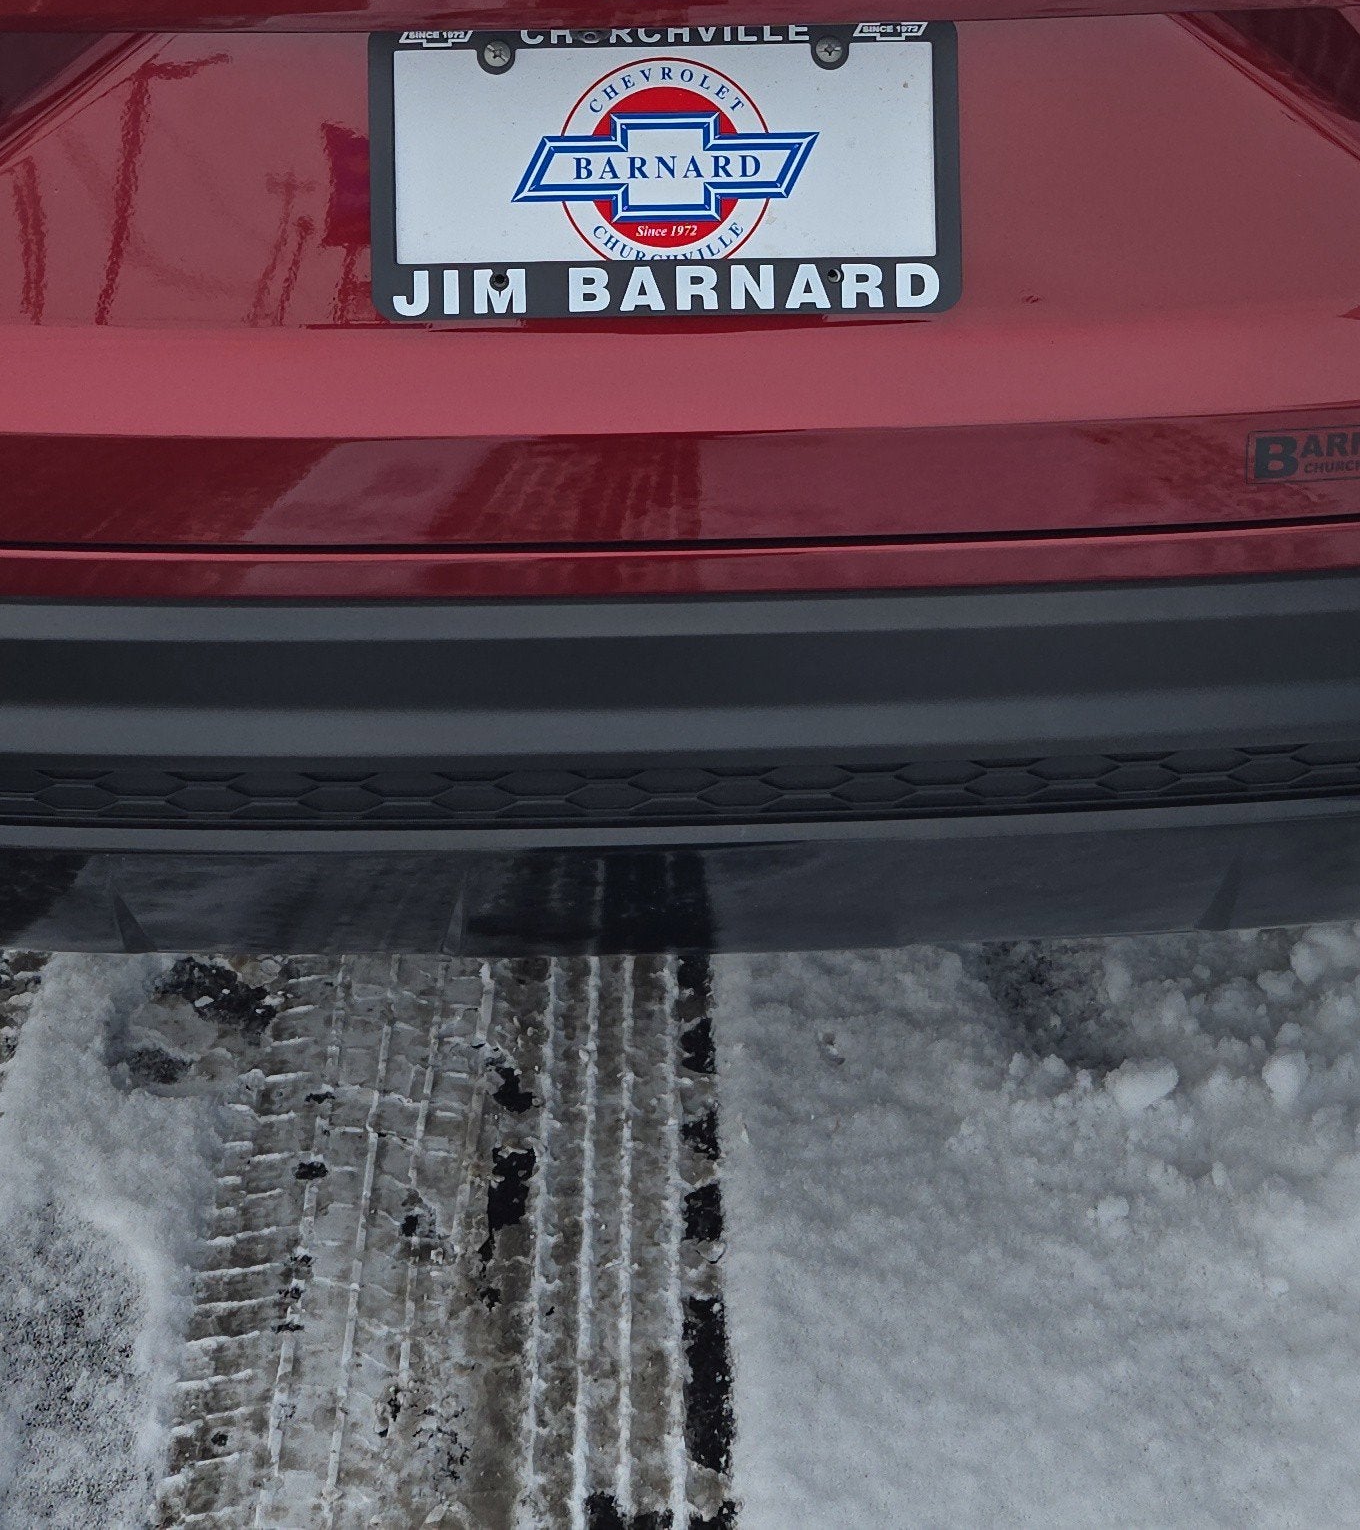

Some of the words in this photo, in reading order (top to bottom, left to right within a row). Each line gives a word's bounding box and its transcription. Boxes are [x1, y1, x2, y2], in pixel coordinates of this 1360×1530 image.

[589, 66, 745, 114] CHEVROLET
[573, 155, 762, 180] BARNARD
[636, 226, 668, 236] Since
[670, 225, 697, 236] 1972
[393, 269, 527, 317] JIM
[568, 263, 940, 313] BARNARD
